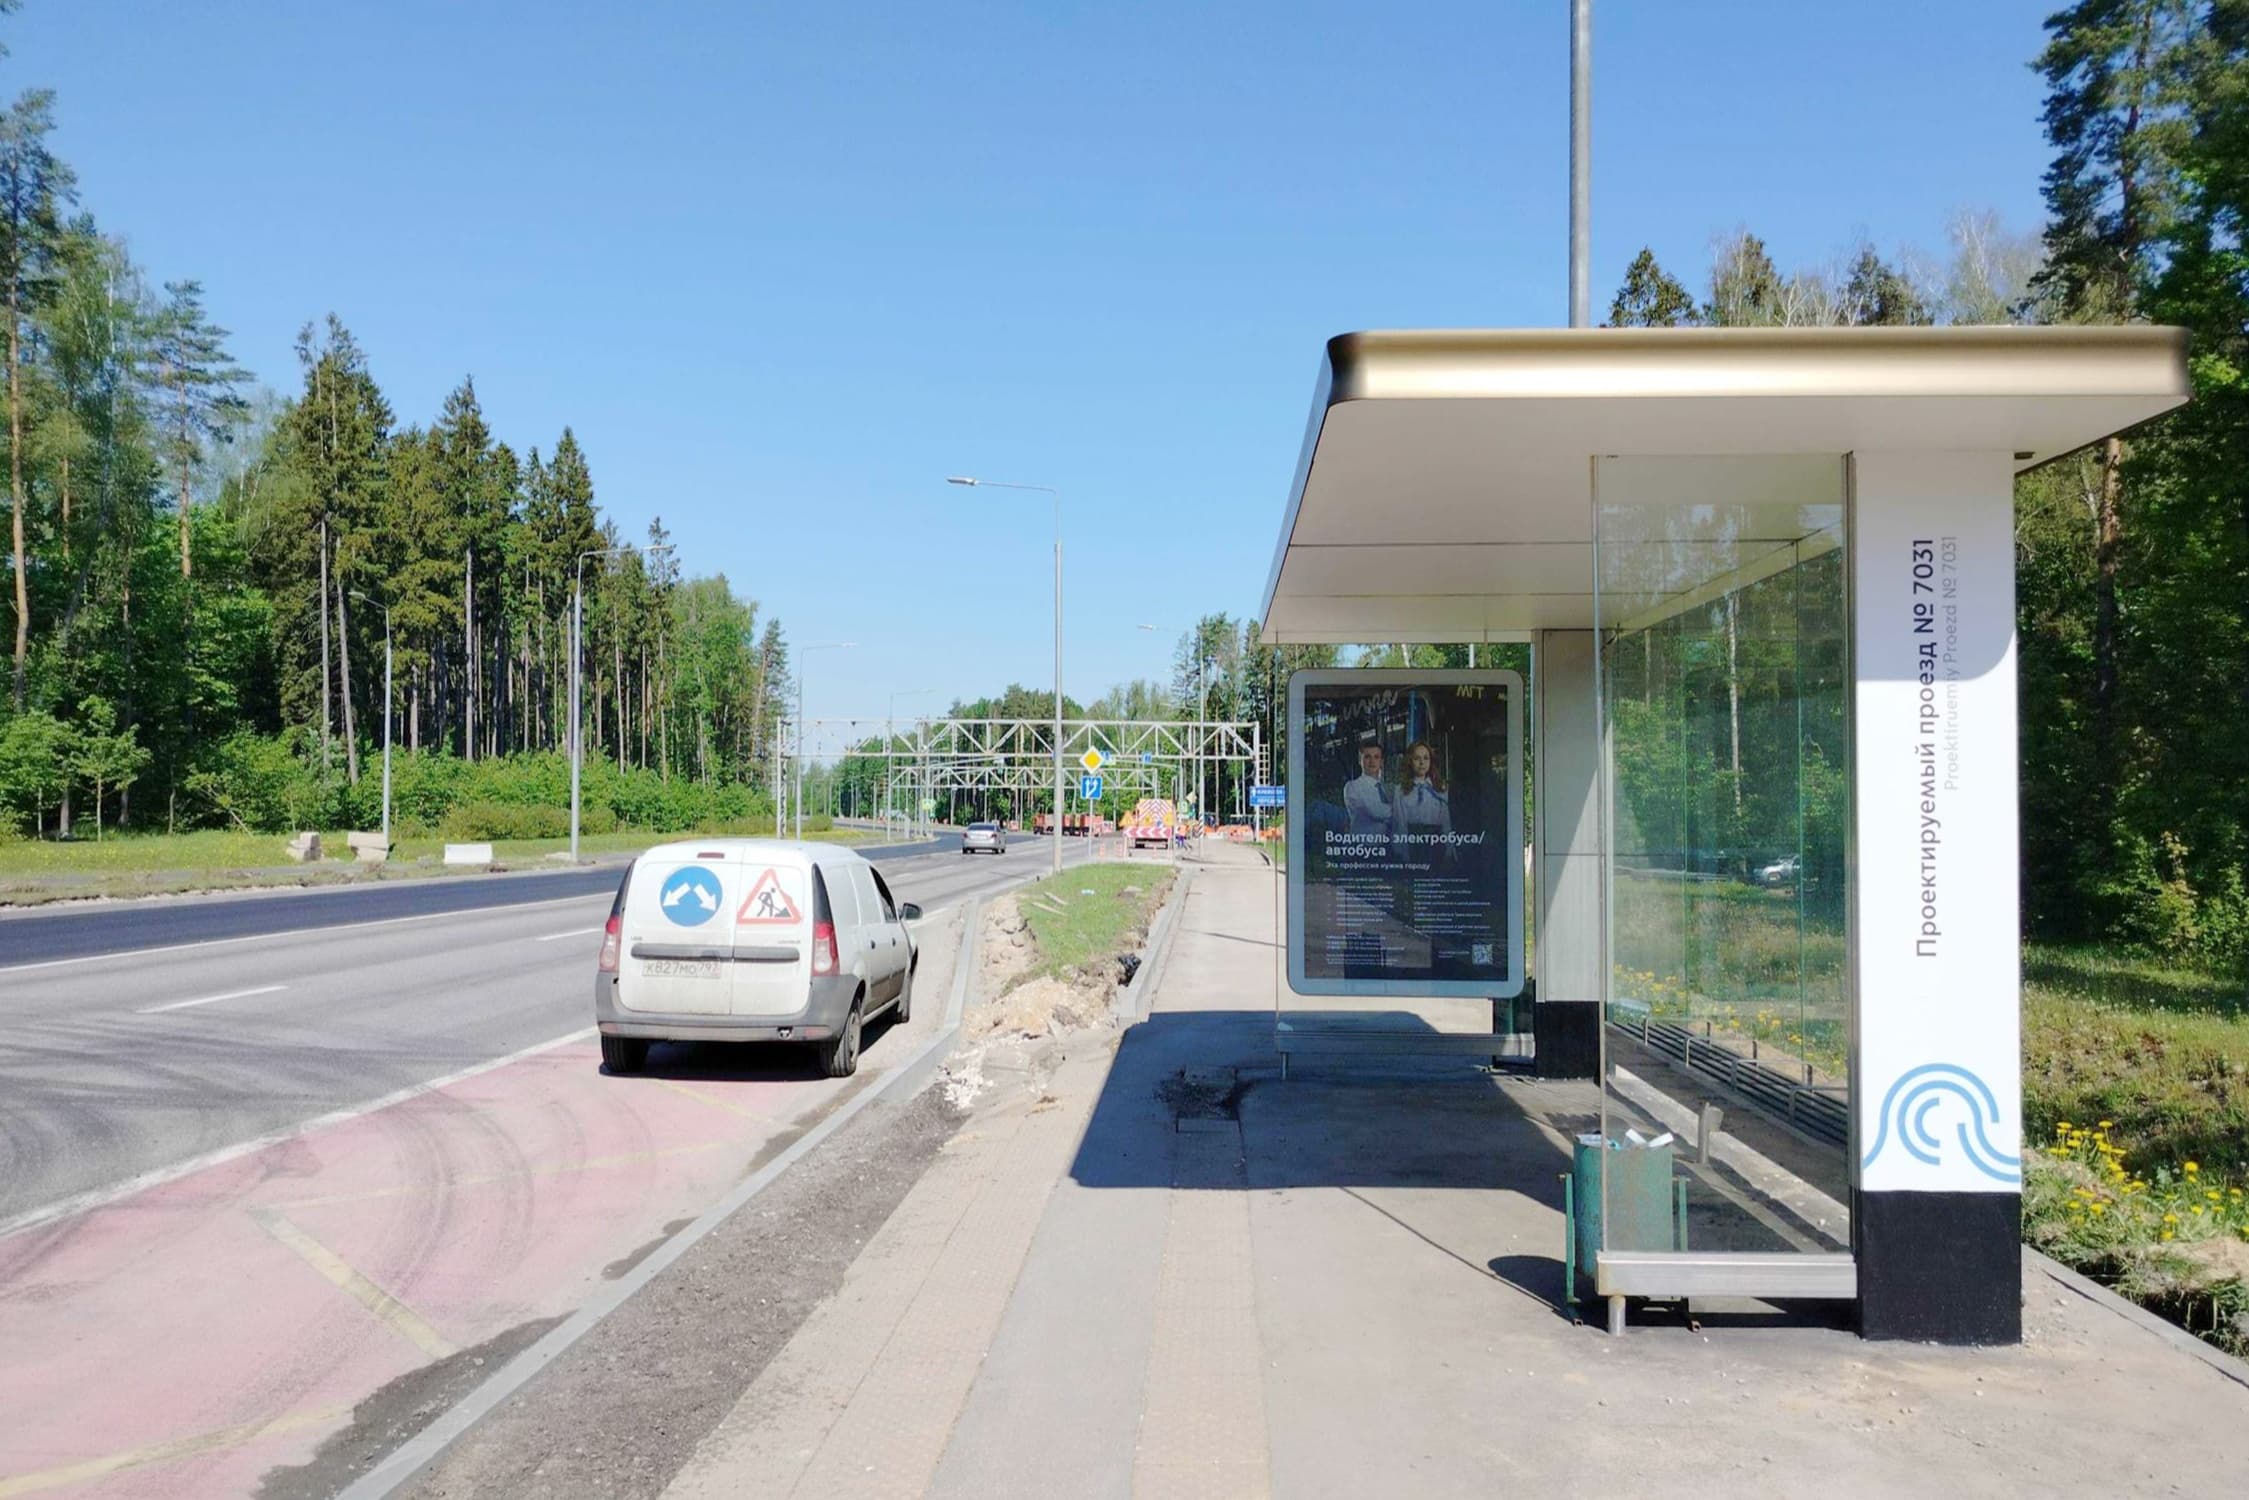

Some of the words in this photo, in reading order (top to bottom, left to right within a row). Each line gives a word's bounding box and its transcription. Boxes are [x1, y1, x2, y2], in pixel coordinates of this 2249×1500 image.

[1912, 540, 1934, 595] 7031
[1942, 536, 1957, 573] 7031
[1942, 578, 1957, 599] №
[1912, 602, 1934, 633] №
[1942, 604, 1957, 663] Proezd
[1919, 642, 1940, 734] проезд
[1325, 830, 1390, 844] Водитель
[1392, 831, 1486, 846] электробуса/
[1325, 844, 1387, 859] автобуса
[1914, 743, 1942, 957] Проектируемый
